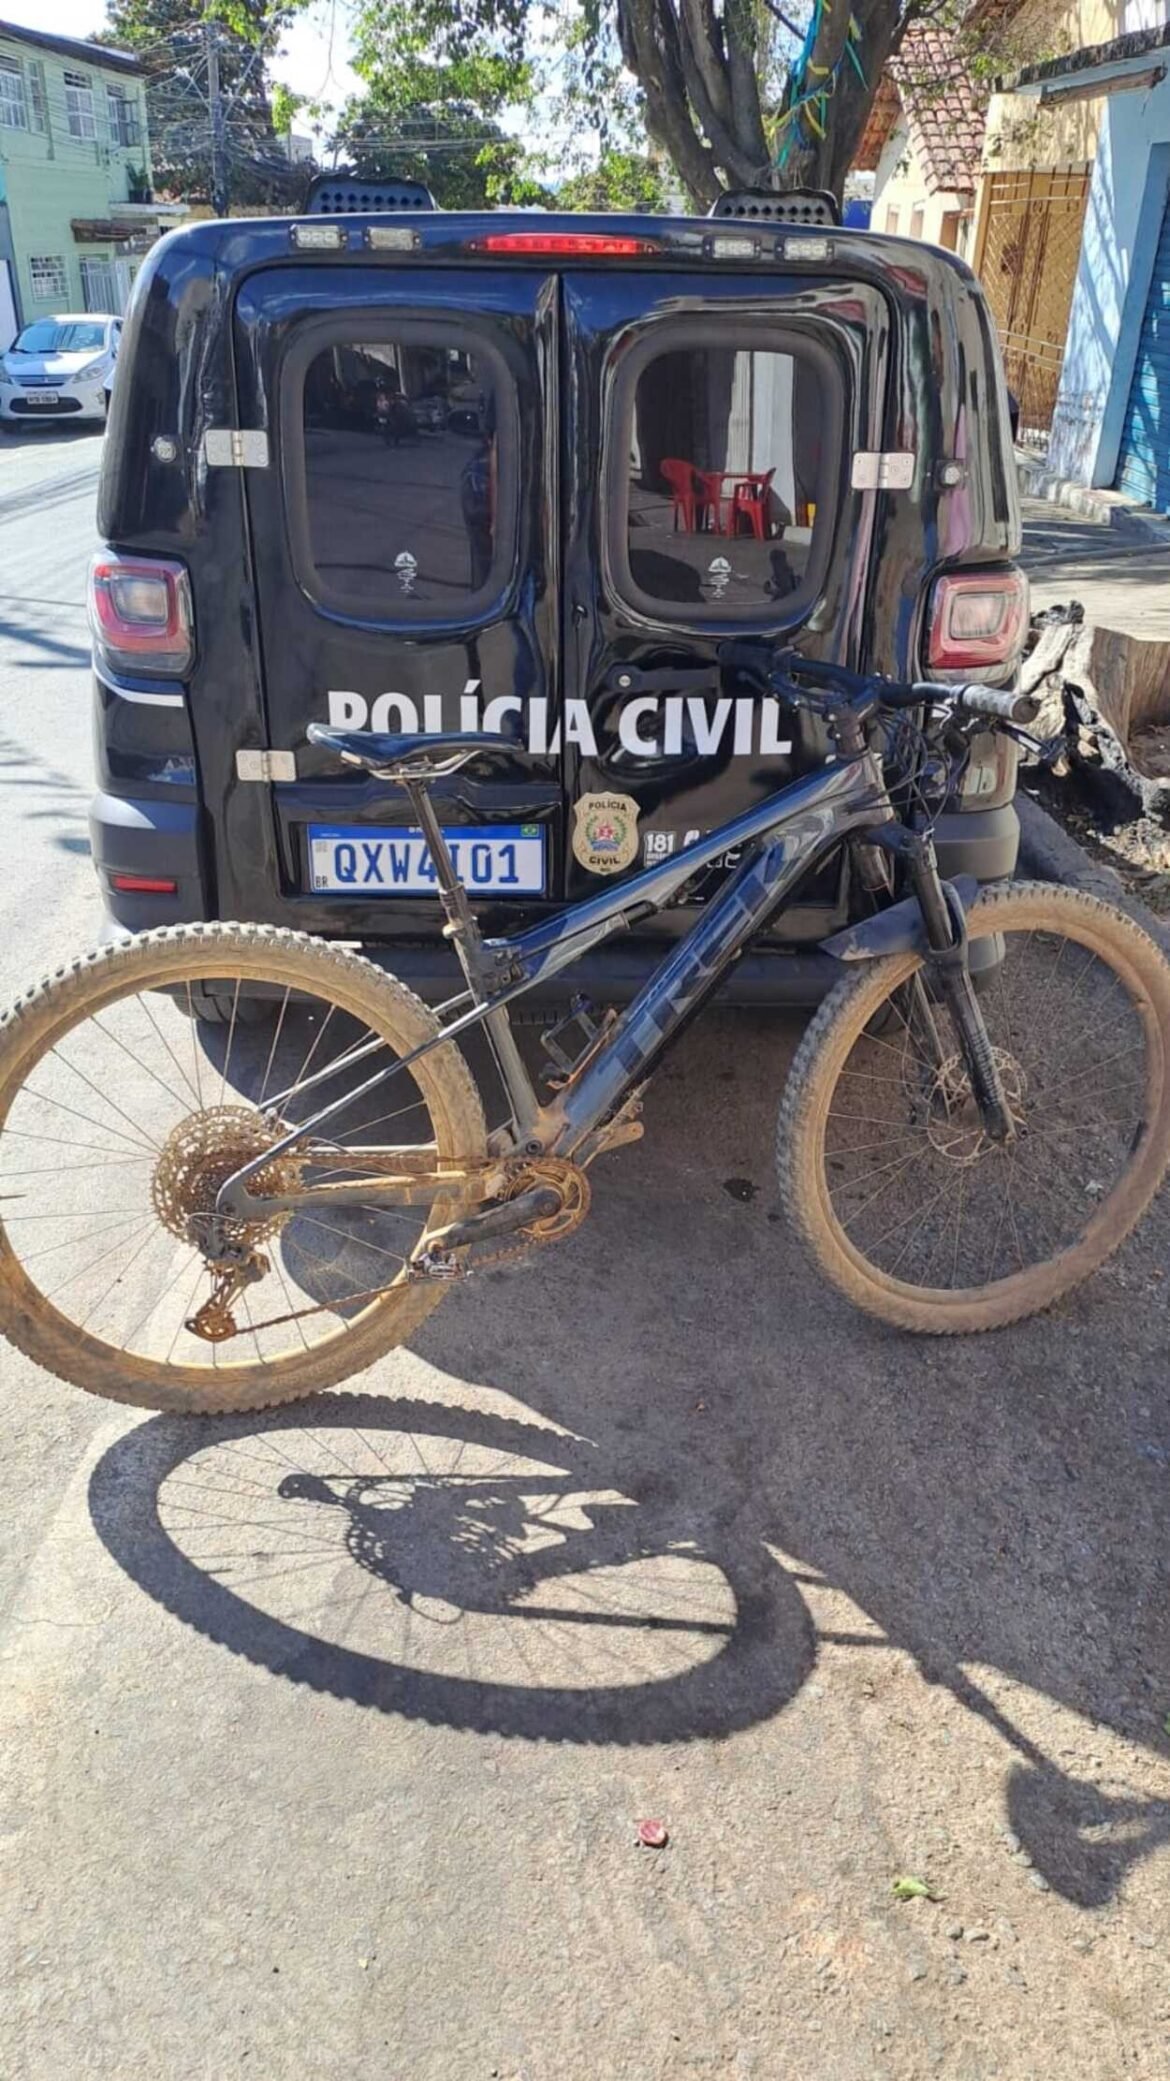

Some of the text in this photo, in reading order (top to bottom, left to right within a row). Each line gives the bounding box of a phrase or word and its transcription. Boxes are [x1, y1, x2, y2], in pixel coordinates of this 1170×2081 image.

[328, 680, 792, 756] POLÍCIA CIVIL
[588, 801, 627, 811] POLÍCIA
[646, 833, 673, 852] 181
[589, 855, 620, 865] CIVIL
[316, 876, 329, 888] BR
